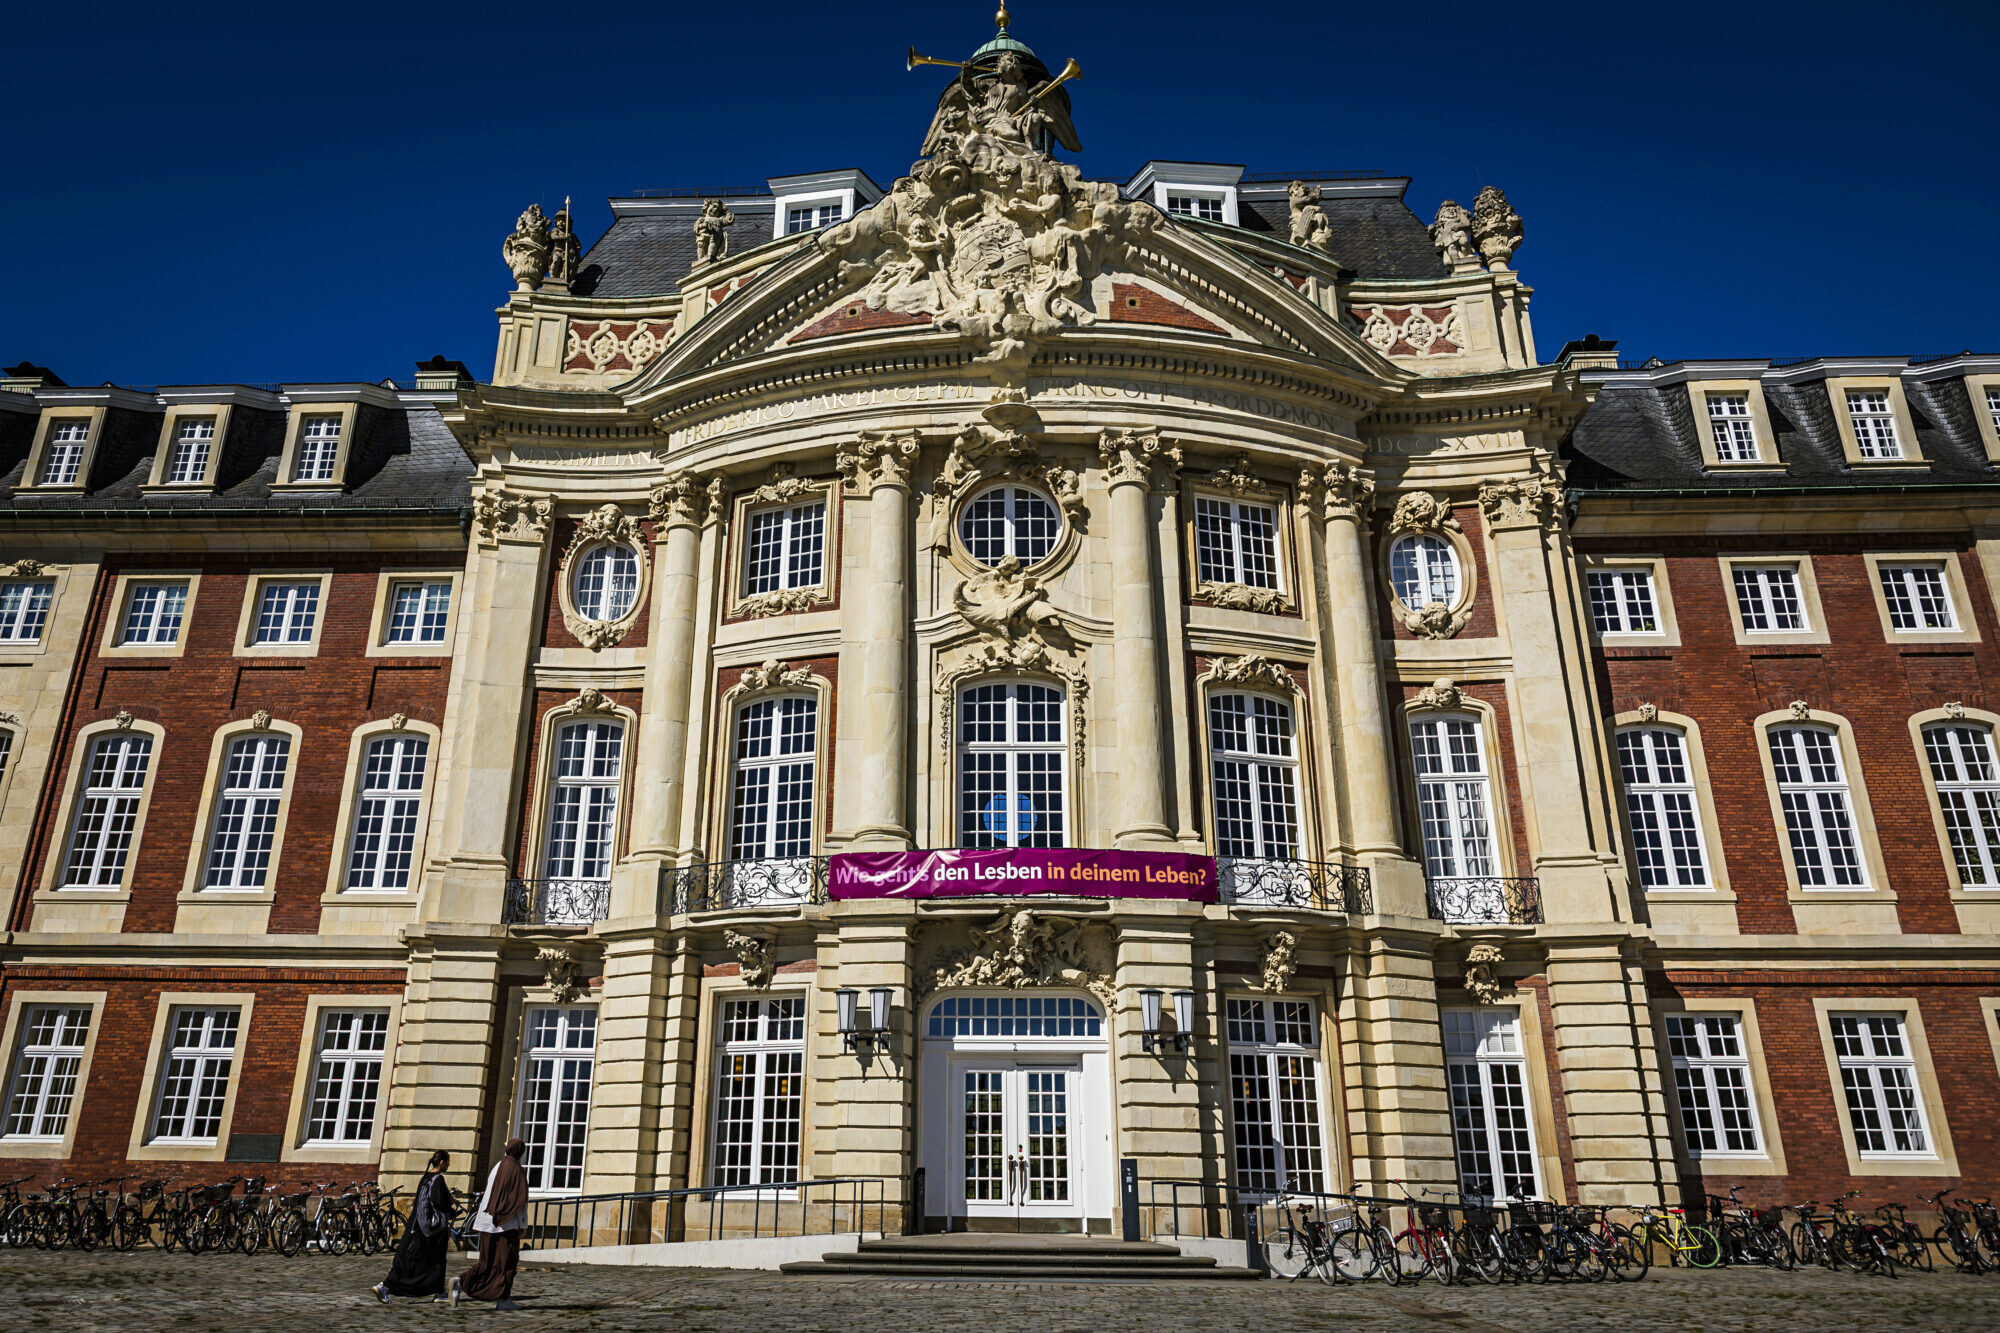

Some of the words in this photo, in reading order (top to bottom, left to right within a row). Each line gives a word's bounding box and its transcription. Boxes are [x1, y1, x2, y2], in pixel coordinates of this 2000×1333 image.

[684, 401, 795, 445] FRIDERICO
[836, 865, 870, 885] Wie
[934, 863, 968, 881] den
[974, 861, 1042, 880] Lesben
[1047, 862, 1065, 880] in
[1070, 862, 1140, 882] deinem
[1145, 865, 1207, 886] Leben?
